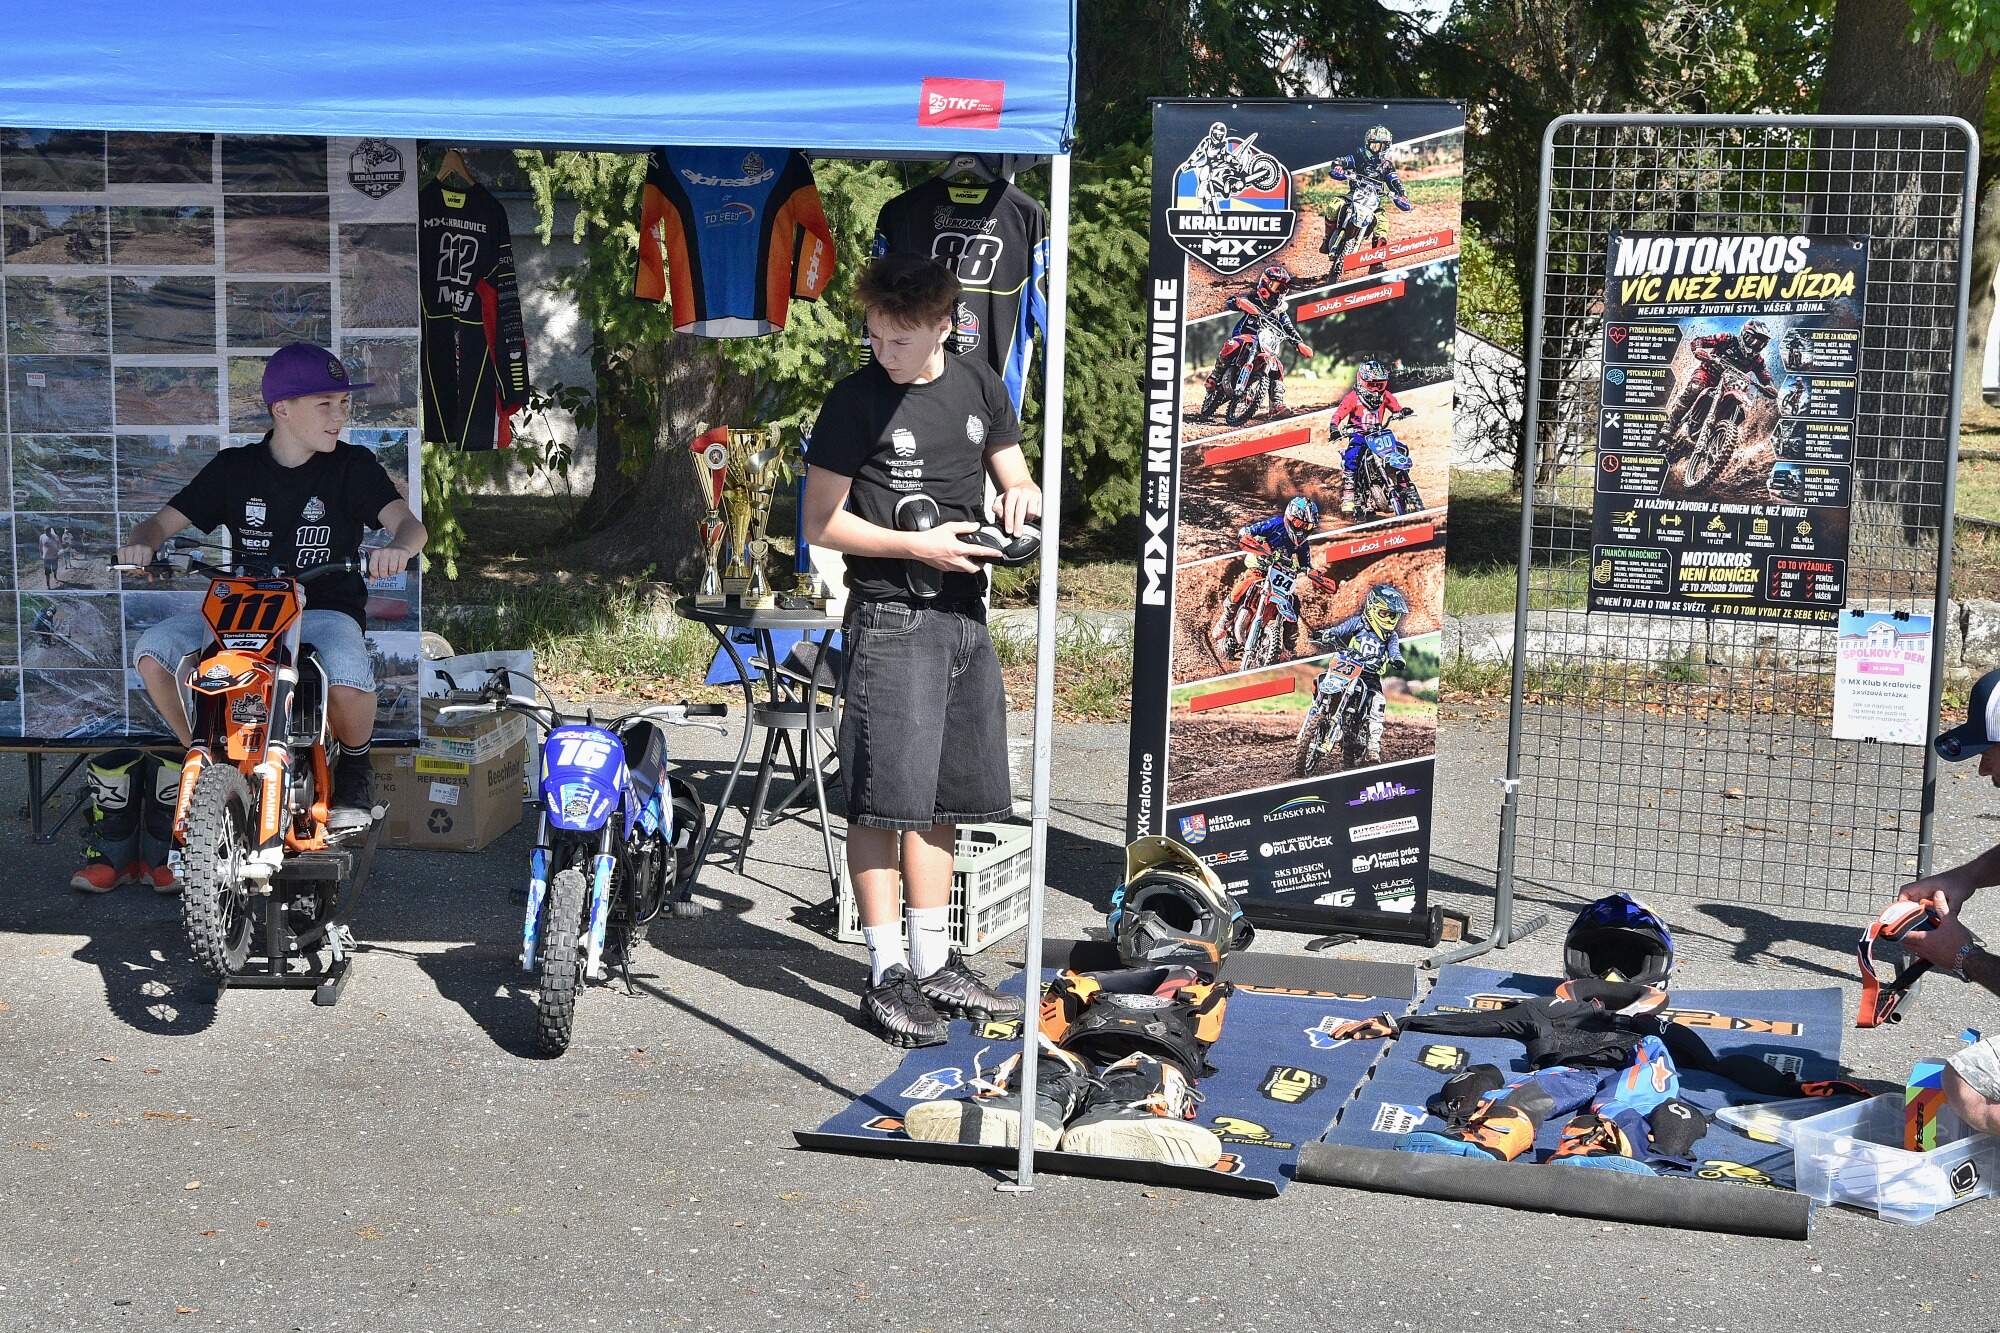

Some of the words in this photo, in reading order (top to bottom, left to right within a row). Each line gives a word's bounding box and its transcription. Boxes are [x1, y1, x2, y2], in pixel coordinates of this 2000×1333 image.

[948, 97, 980, 110] TKF
[354, 173, 400, 181] KRALOVICE
[365, 183, 390, 191] MX
[448, 217, 487, 233] KRALOVICE
[1178, 215, 1282, 232] KRALOVICE
[1201, 239, 1258, 256] MX
[1614, 235, 1811, 276] MOTOKROS
[1216, 257, 1240, 267] 2022
[1620, 271, 1660, 306] VÍC
[1665, 268, 1721, 304] NEŽ
[1724, 272, 1779, 301] JEN
[1781, 266, 1856, 301] JÍZDA
[1313, 298, 1342, 313] Jakub
[1637, 306, 1666, 316] NEJEN
[1667, 304, 1697, 315] SPORT.
[1736, 302, 1761, 314] STYL.
[1147, 278, 1178, 473] KRALOVICE
[1375, 435, 1393, 451] 30
[1157, 475, 1171, 510] 2022
[1634, 498, 1644, 509] ZA
[1644, 498, 1675, 510] KAŽDÝM
[1676, 500, 1709, 512] ZÁVODEM
[1709, 502, 1719, 513] JE
[1719, 504, 1750, 515] MNOHEM
[1765, 505, 1780, 516] NEŽ
[296, 525, 331, 547] 100
[296, 548, 331, 569] 88
[1142, 510, 1169, 606] MX
[1601, 548, 1627, 557] FINANČNÍ
[1628, 550, 1662, 560] NÁROČNOST
[1681, 551, 1753, 567] MOTOKROS
[1777, 560, 1787, 569] CO
[1788, 561, 1797, 570] TO
[1798, 560, 1834, 572] VYŽADUJE:
[1678, 566, 1708, 582] NENÍ
[1708, 566, 1760, 583] KONÍČEK
[1272, 574, 1294, 592] 84
[1680, 583, 1690, 592] JE
[1690, 583, 1699, 592] TO
[1700, 582, 1727, 593] ZPŮSOB
[1727, 583, 1755, 593] ŽIVOTA!
[1780, 580, 1793, 589] SÍLU
[1780, 589, 1791, 598] ČAS
[216, 593, 287, 631] 111
[1603, 596, 1621, 607] NENÍ
[1622, 598, 1632, 608] TO
[1633, 598, 1647, 608] JEN
[1647, 600, 1654, 609] O
[1655, 600, 1671, 610] TOM
[1671, 601, 1681, 611] SE
[1682, 600, 1707, 613] SVÉZT.
[1711, 604, 1721, 614] JE
[1722, 604, 1733, 615] TO
[1733, 605, 1739, 615] O
[1740, 605, 1756, 616] TOM
[1758, 607, 1782, 618] VYDAT
[1782, 608, 1793, 619] ZE
[1793, 609, 1813, 620] SEBE
[1814, 609, 1832, 621] VŠE!
[1903, 651, 1926, 664] DEN
[1848, 678, 1861, 686] MX
[1862, 679, 1881, 687] Klub
[1882, 680, 1921, 690] Kralovice
[557, 739, 612, 769] 16
[1359, 786, 1407, 803] SKYLINE
[1208, 814, 1234, 826] MĚSTO
[1263, 808, 1305, 822] PLZEŇSKÝ
[1305, 804, 1326, 814] KRAJ
[1209, 818, 1251, 832] KRALOVICE
[1273, 843, 1297, 856] PILA
[1297, 835, 1334, 851] BUČEK
[1377, 848, 1400, 860] Zemní
[1400, 846, 1420, 857] práce
[1274, 868, 1292, 878] SKS
[1291, 862, 1325, 875] DESIGN
[1380, 858, 1400, 869] Matěj
[1270, 868, 1332, 888] TRUHLÁŘSTVÍ
